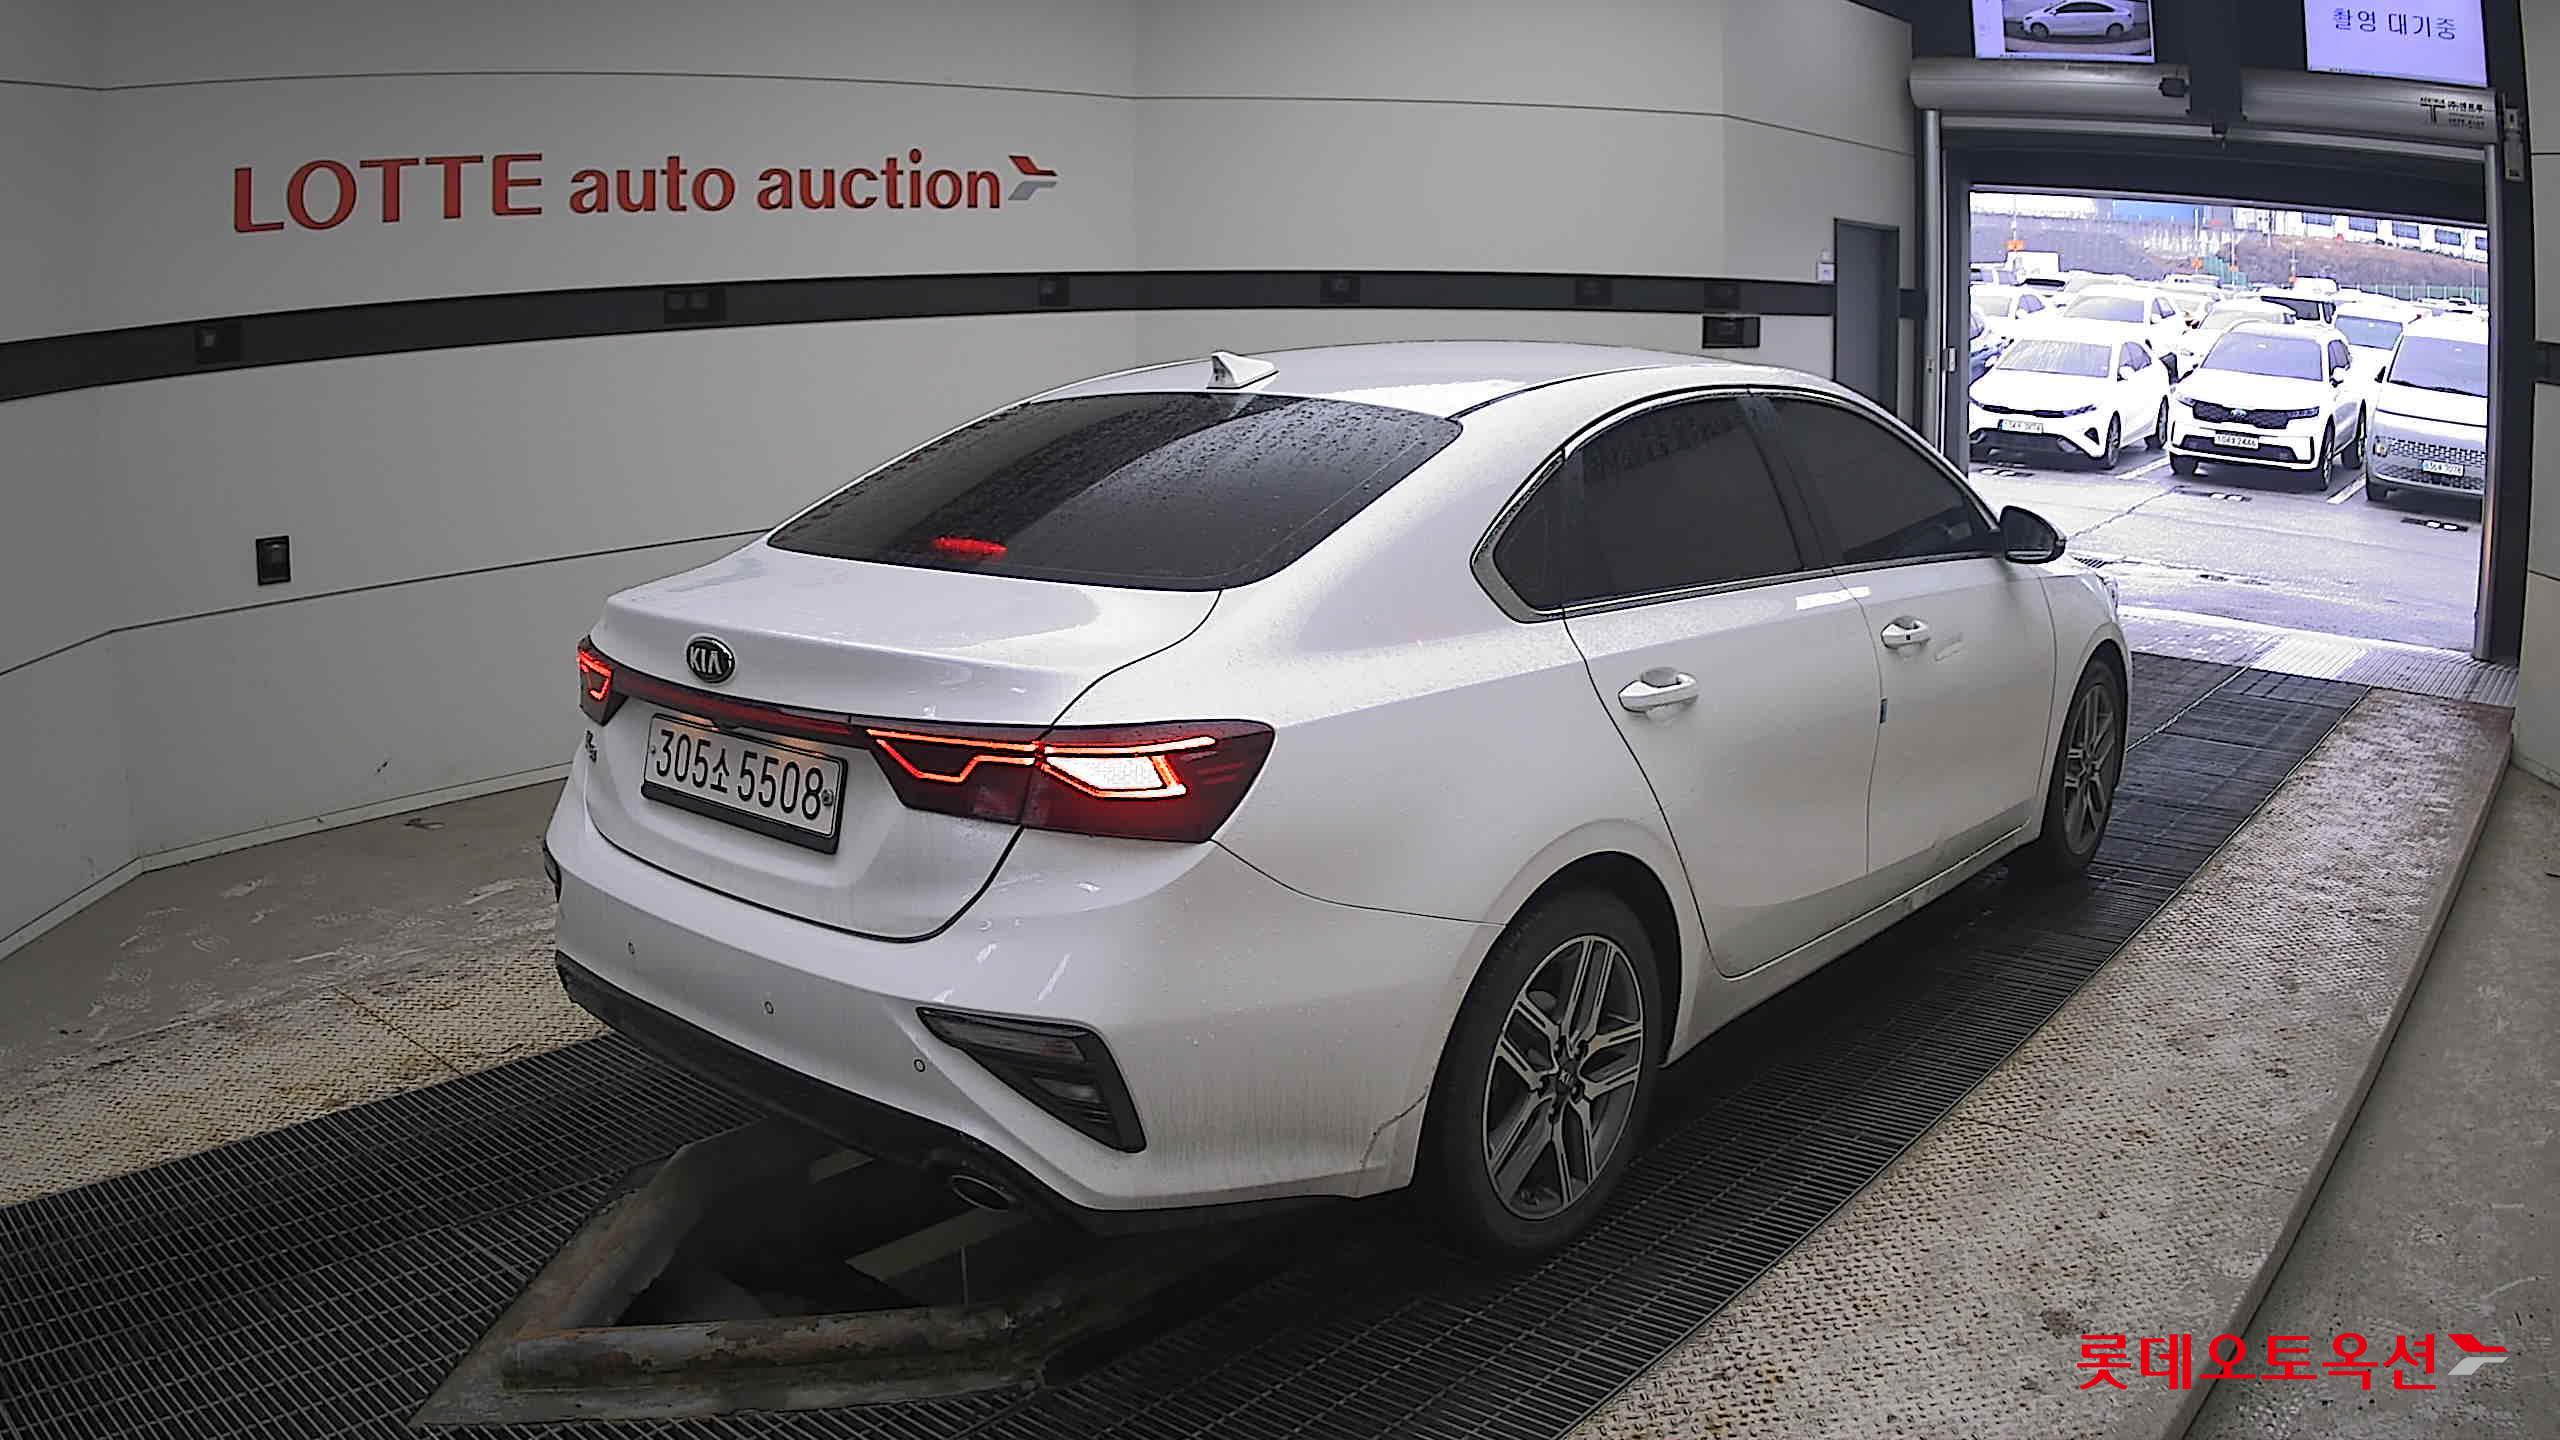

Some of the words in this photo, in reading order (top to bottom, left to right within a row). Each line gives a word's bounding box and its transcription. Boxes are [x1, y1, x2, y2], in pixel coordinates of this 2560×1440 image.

[2333, 8, 2376, 32] 촬영
[2388, 12, 2456, 40] 대기중
[234, 153, 543, 233] LOTTE
[569, 157, 736, 213] auto
[758, 149, 1001, 209] auction
[690, 646, 722, 674] KIA
[656, 729, 730, 793] 305소
[737, 750, 824, 820] 5508
